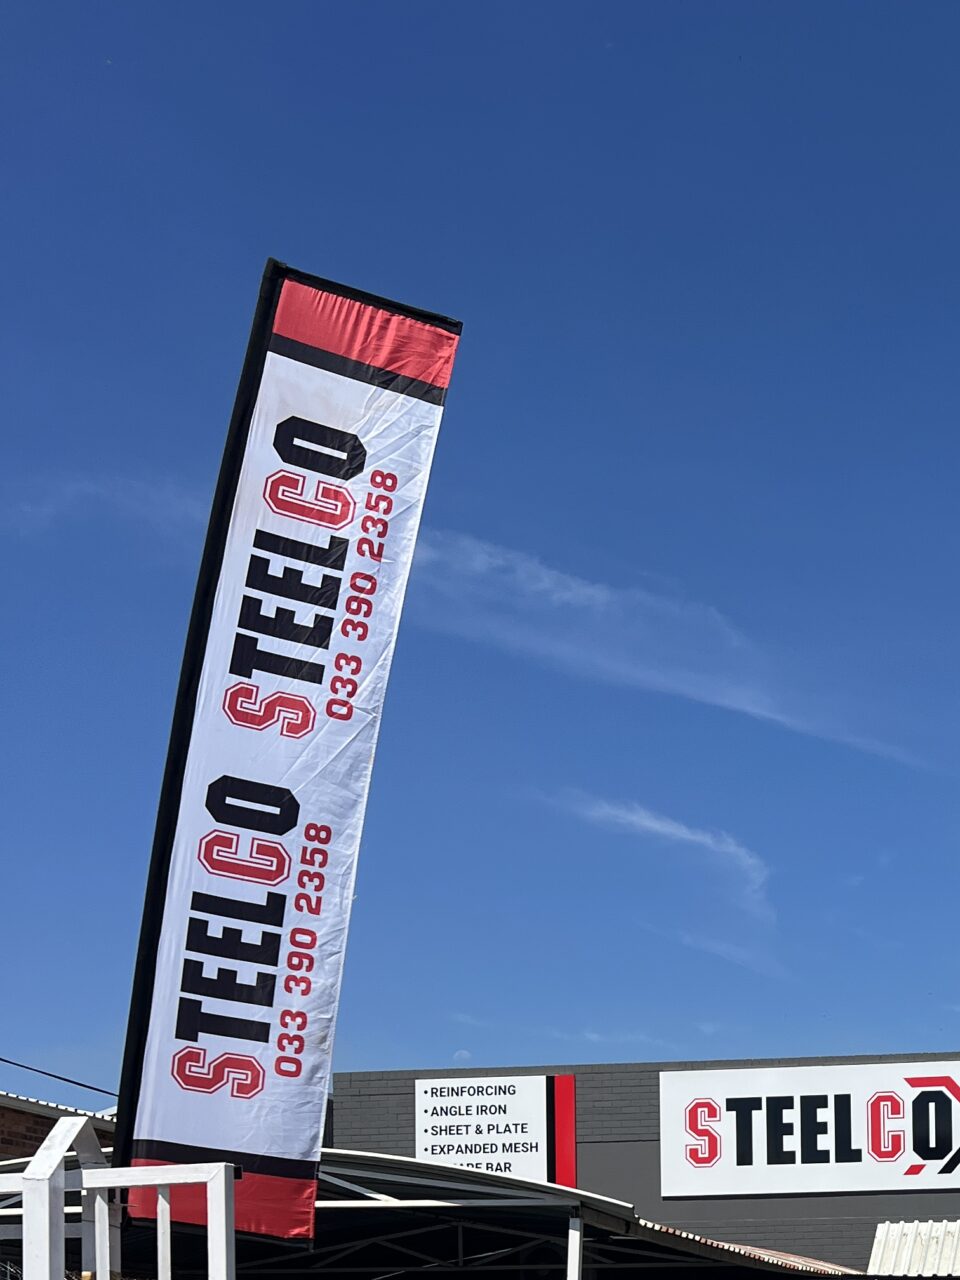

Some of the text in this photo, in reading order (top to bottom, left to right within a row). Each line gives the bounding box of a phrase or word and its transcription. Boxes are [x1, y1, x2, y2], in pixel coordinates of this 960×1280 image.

[222, 415, 367, 738] STEELCO
[325, 469, 398, 721] 033 390 2358
[171, 774, 301, 1100] STEELCO
[274, 822, 333, 1078] 033 390 2358
[430, 1085, 516, 1097] REINFORCING
[430, 1104, 507, 1117] ANGLE IRON
[430, 1122, 528, 1136] SHEET & PLATE
[431, 1142, 538, 1155] EXPANDED MESH
[486, 1162, 512, 1172] BAR
